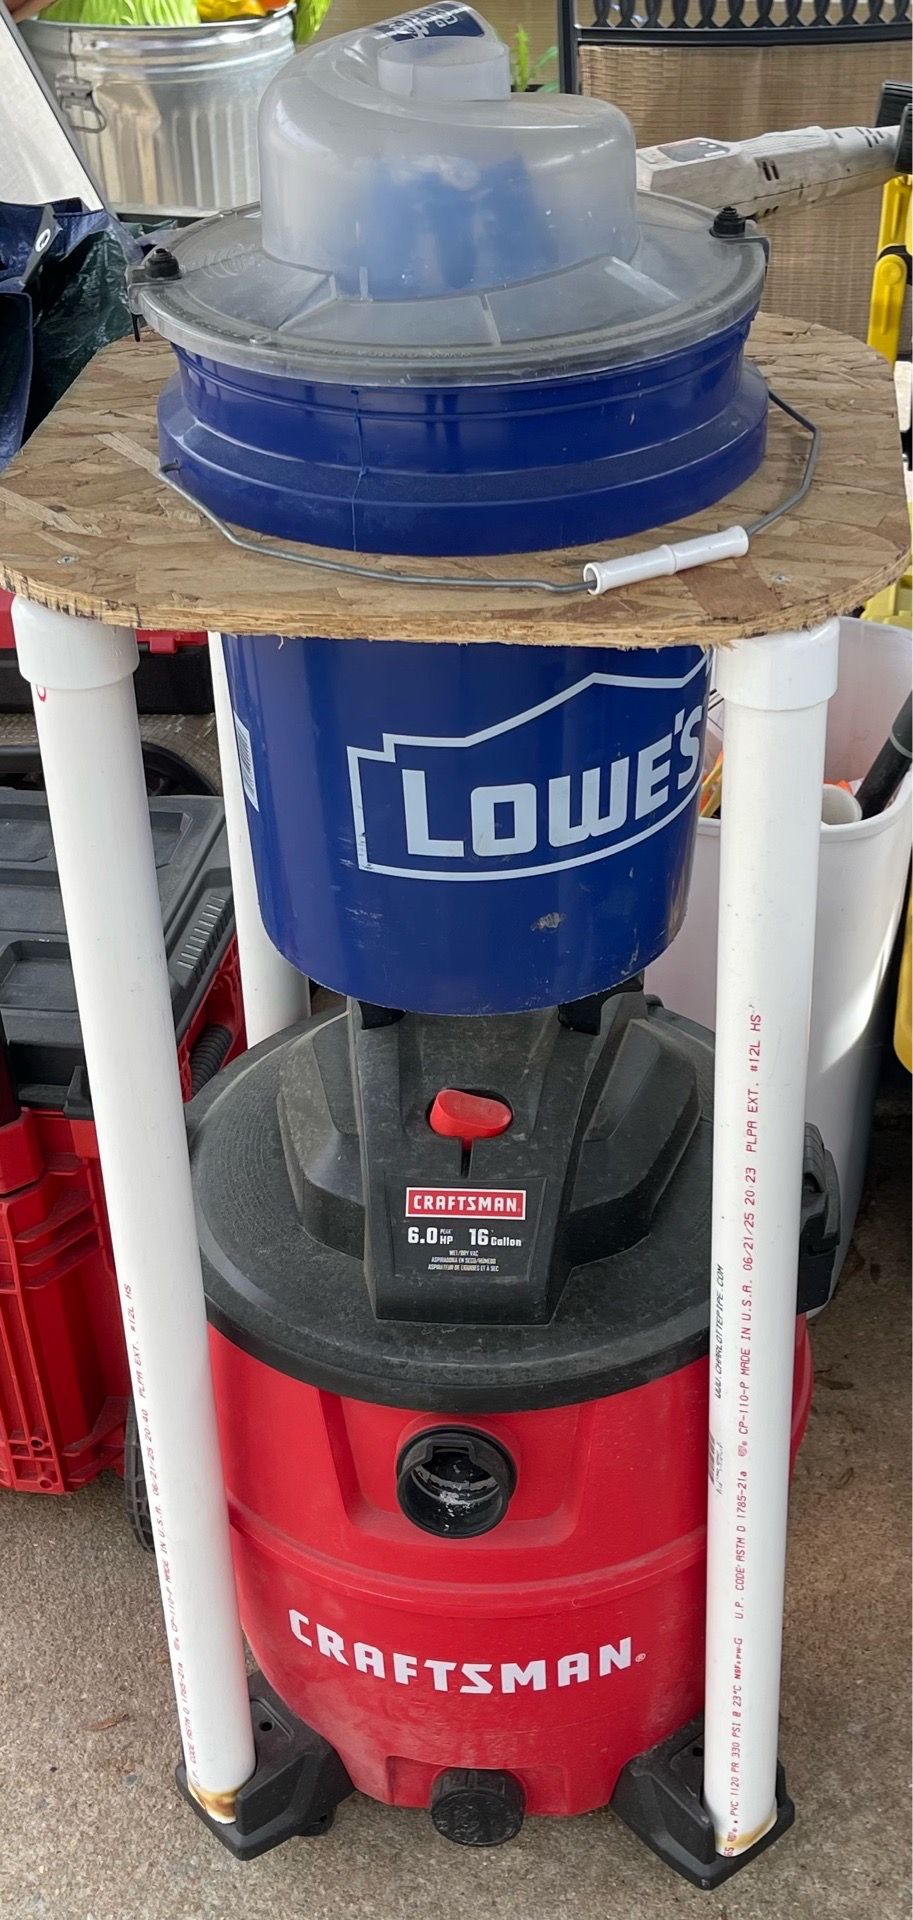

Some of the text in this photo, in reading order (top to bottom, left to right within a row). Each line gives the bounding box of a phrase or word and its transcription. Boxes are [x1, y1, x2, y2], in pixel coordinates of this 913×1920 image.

[401, 704, 702, 857] LOWE'S
[751, 1015, 761, 1031] HS
[749, 1041, 760, 1072] #12L
[748, 1082, 759, 1112] EXT.
[746, 1121, 758, 1152] PLPA
[413, 1195, 517, 1212] CRAFTSMAN
[407, 1227, 438, 1244] 6.0
[440, 1236, 453, 1245] HP
[469, 1228, 489, 1246] 16
[490, 1236, 522, 1247] Gallon
[743, 1213, 755, 1270] 06/21/25
[124, 1284, 132, 1299] HS
[742, 1279, 753, 1321] U.S.A.
[741, 1328, 752, 1340] IN
[740, 1348, 751, 1375] MADE
[739, 1381, 749, 1434] CP-110-P
[737, 1471, 747, 1518] 1785-21a
[160, 1542, 167, 1554] IN
[736, 1538, 745, 1561] ASTM
[736, 1567, 745, 1590] CODE
[288, 1609, 632, 1694] CRAFTSMAN
[732, 1742, 740, 1758] 330
[731, 1763, 739, 1772] PR
[731, 1777, 739, 1796] 1120
